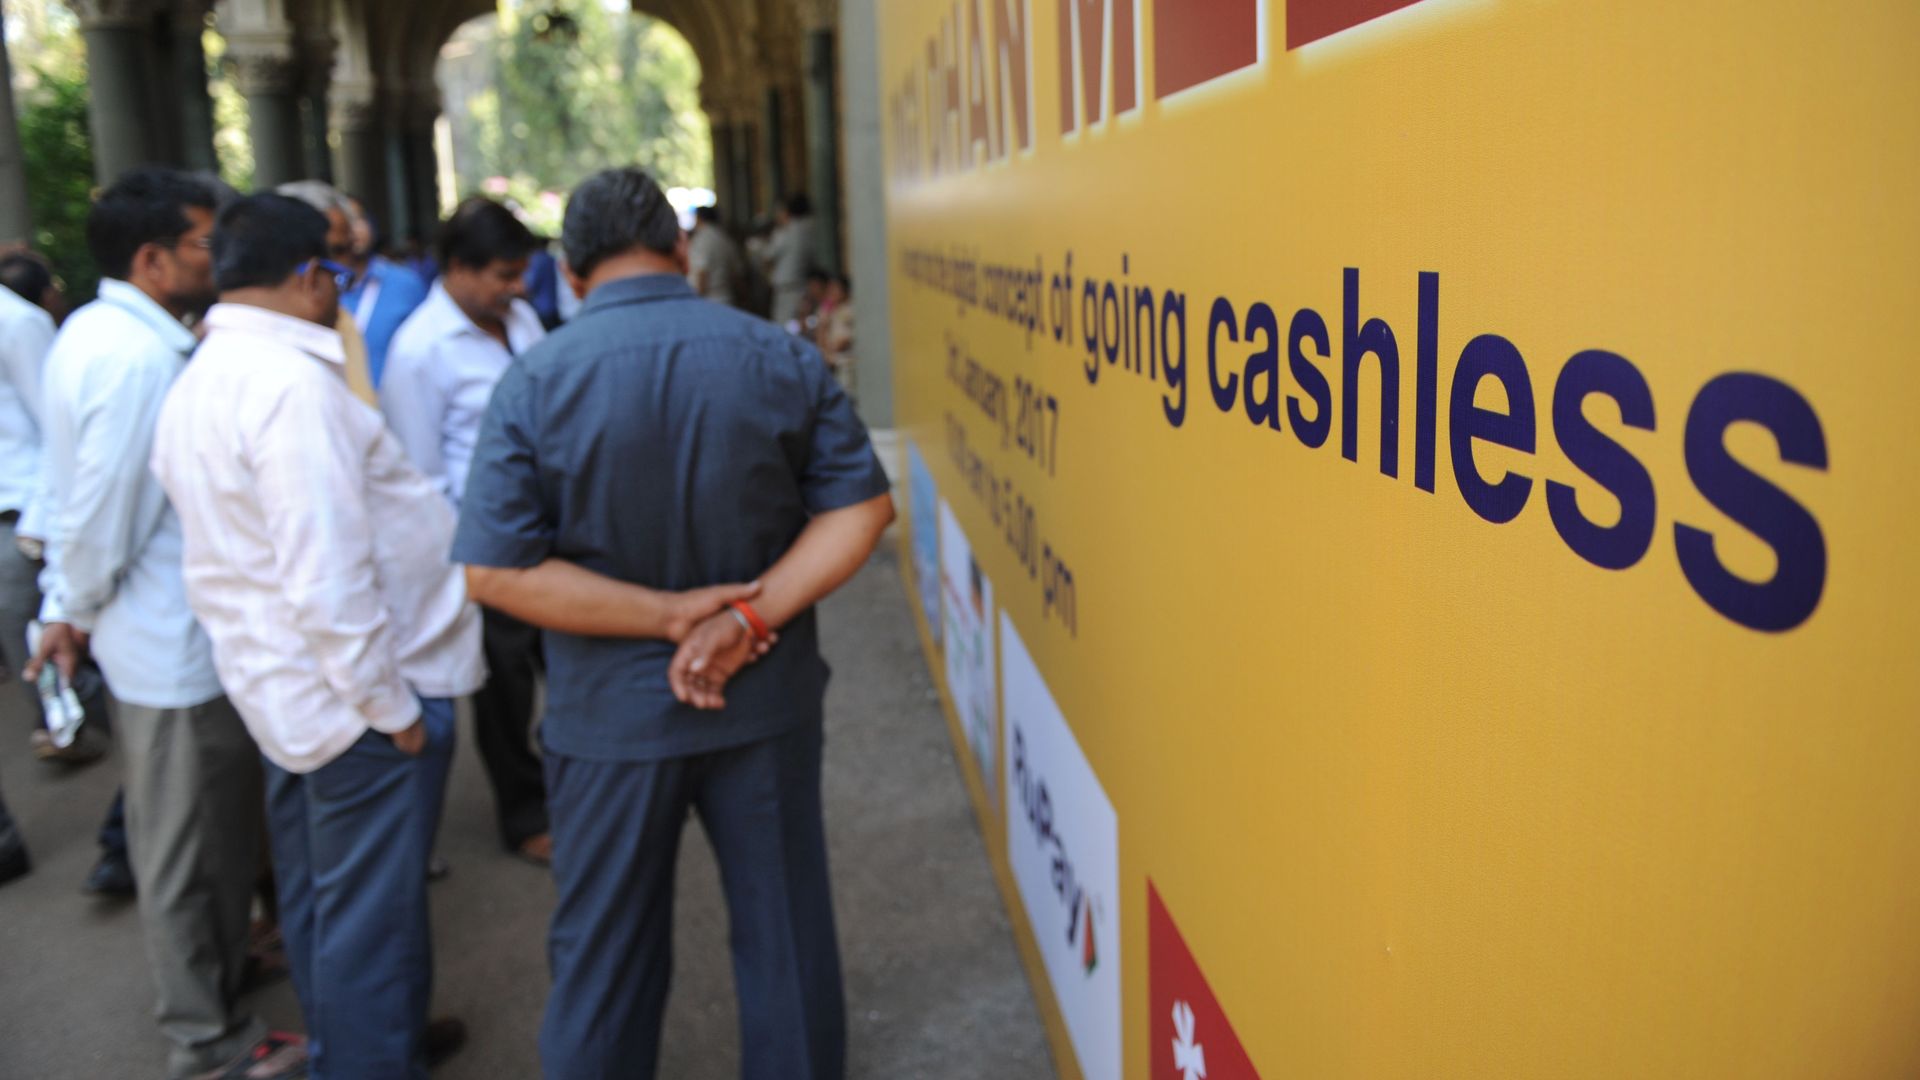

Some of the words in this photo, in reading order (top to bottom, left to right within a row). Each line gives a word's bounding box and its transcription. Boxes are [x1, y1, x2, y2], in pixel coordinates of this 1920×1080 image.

[982, 254, 1045, 351] concept
[1051, 251, 1073, 347] of
[1082, 253, 1187, 429] going
[1206, 266, 1830, 635] cashless
[1014, 374, 1059, 479] 2017
[1042, 539, 1077, 640] pm
[1012, 719, 1083, 948] RuPay
